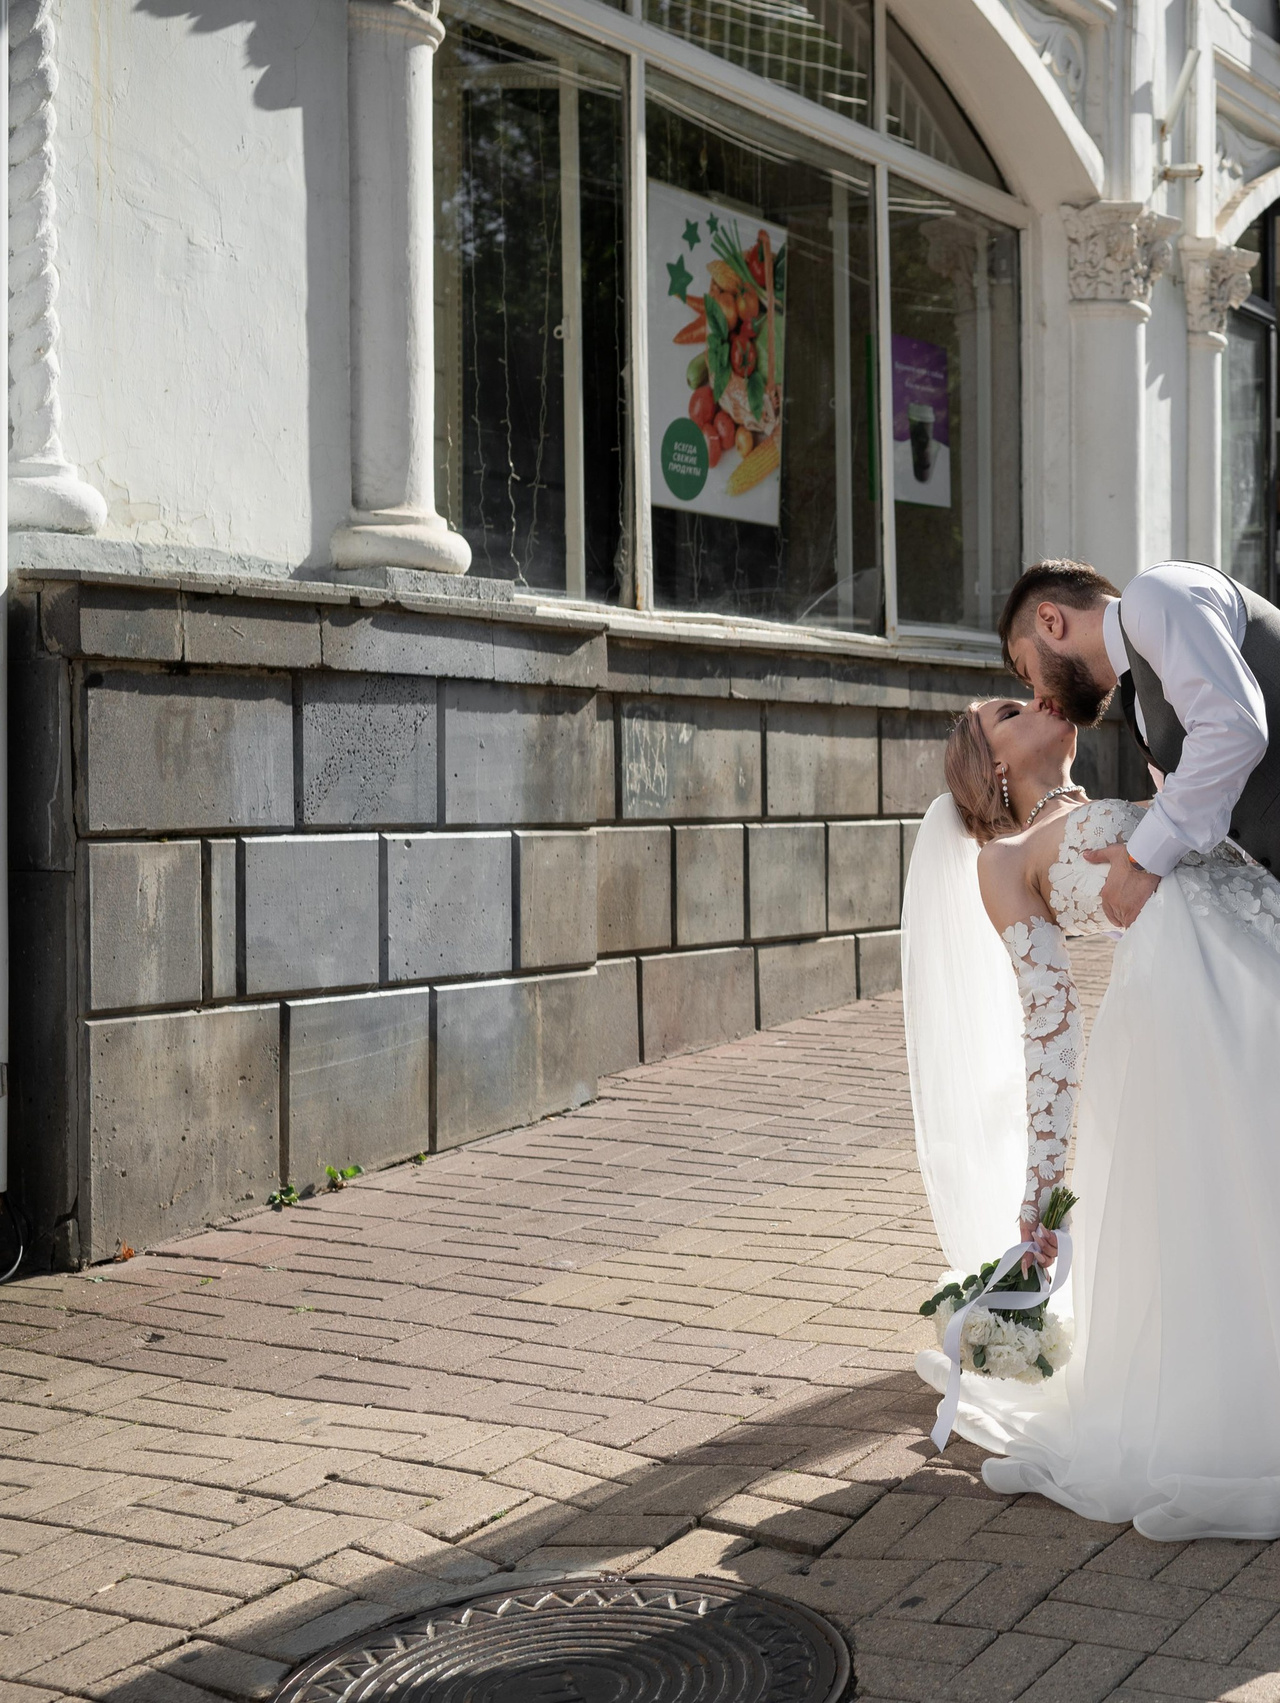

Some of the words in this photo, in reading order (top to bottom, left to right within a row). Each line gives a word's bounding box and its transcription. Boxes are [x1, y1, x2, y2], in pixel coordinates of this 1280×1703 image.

[673, 441, 697, 454] ВСЕГДА
[672, 452, 697, 465] СВЕЖИЕ
[668, 462, 702, 476] ПРОДУКТЫ
